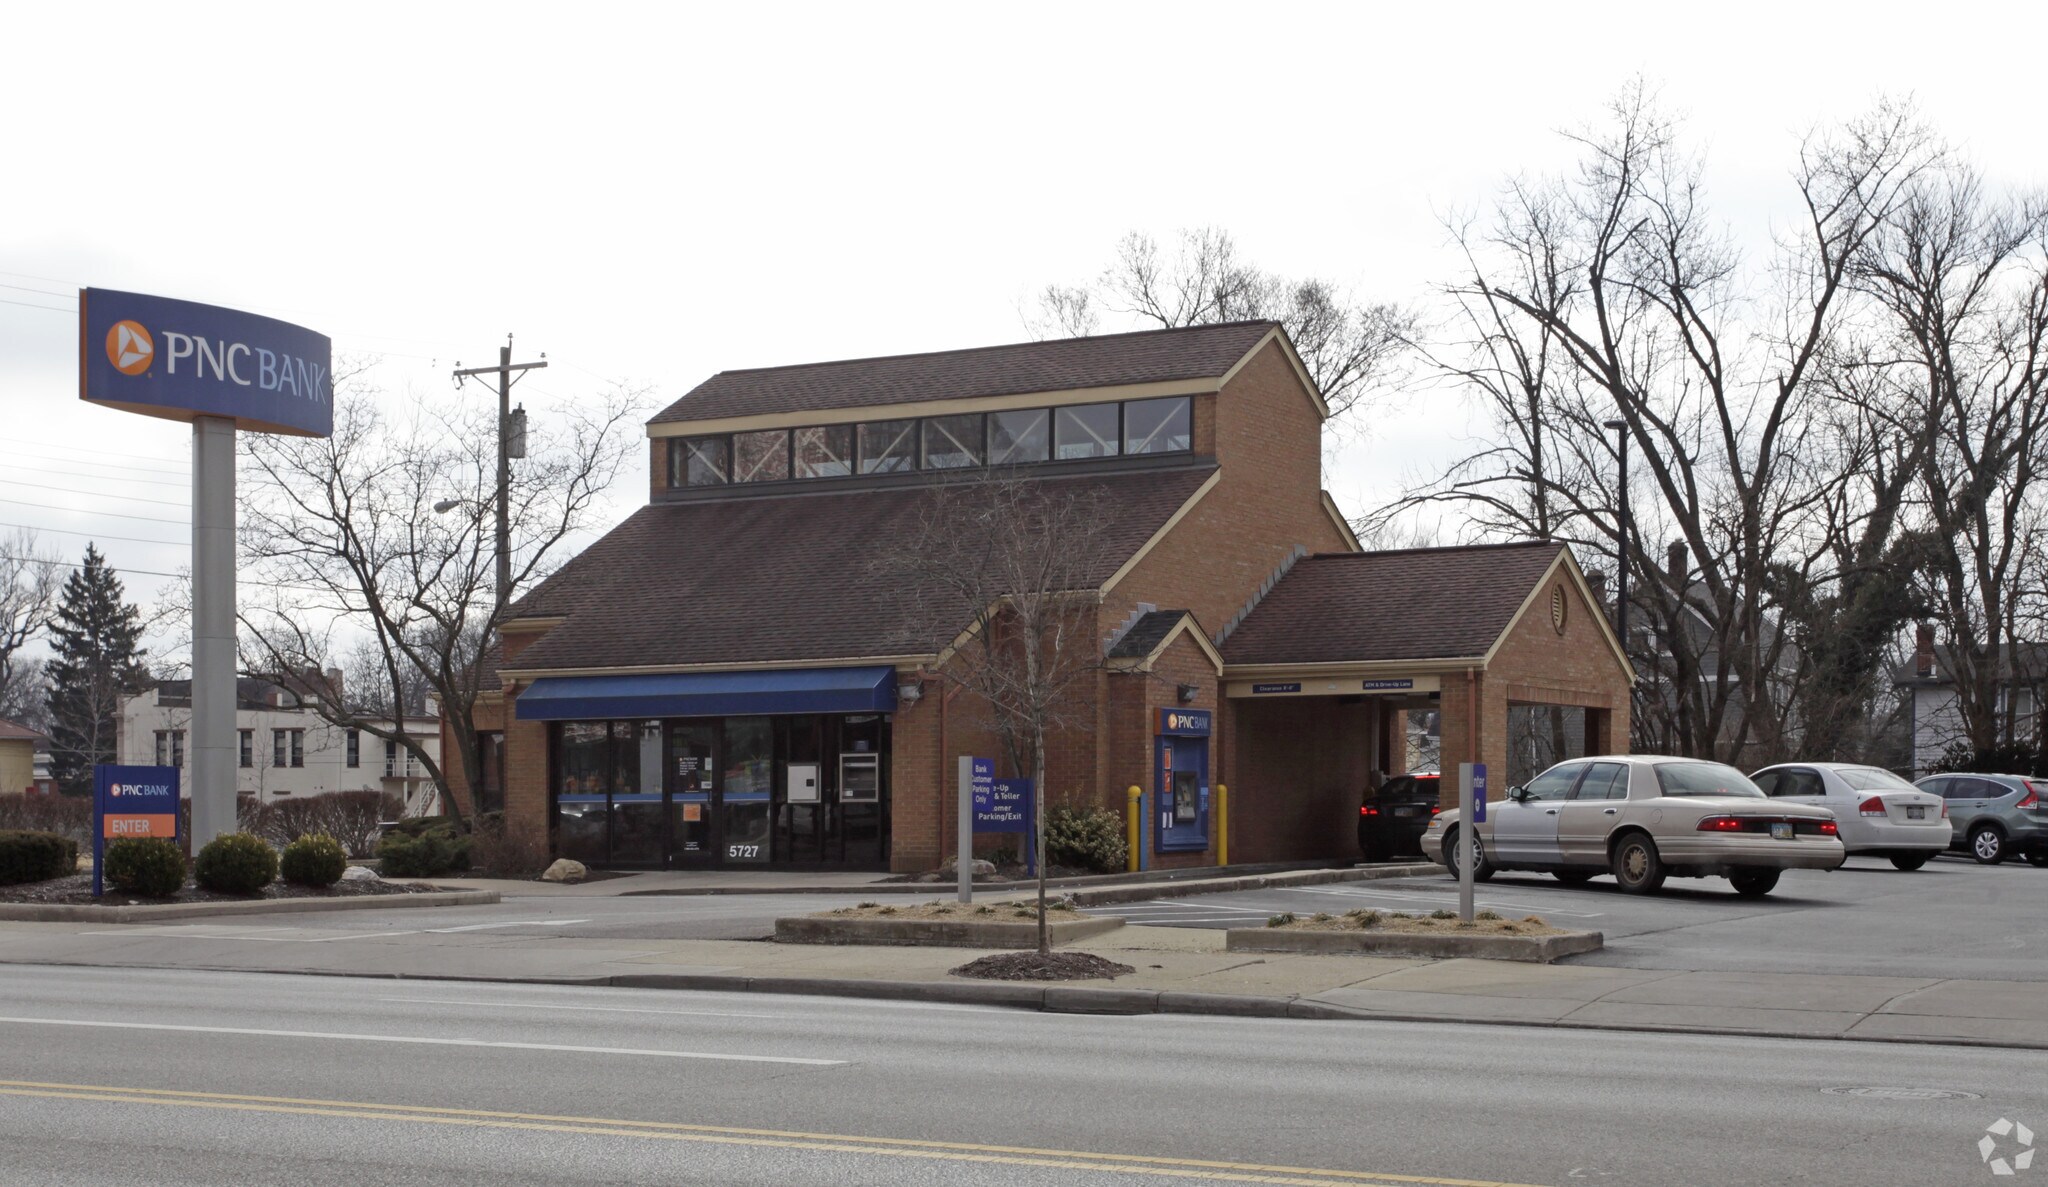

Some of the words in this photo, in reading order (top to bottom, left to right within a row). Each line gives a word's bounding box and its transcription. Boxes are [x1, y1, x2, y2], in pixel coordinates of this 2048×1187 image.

[162, 331, 251, 386] PNC
[255, 347, 326, 405] BANK
[1178, 715, 1194, 729] PNC
[1195, 716, 1208, 729] BANK
[975, 764, 987, 773] Bank
[122, 784, 143, 796] PNC
[143, 784, 169, 796] BANK
[972, 785, 990, 795] Parking
[975, 795, 987, 804] Only
[978, 813, 1022, 821] Parking/Exit
[112, 819, 150, 833] ENTER
[729, 845, 759, 857] 5727
